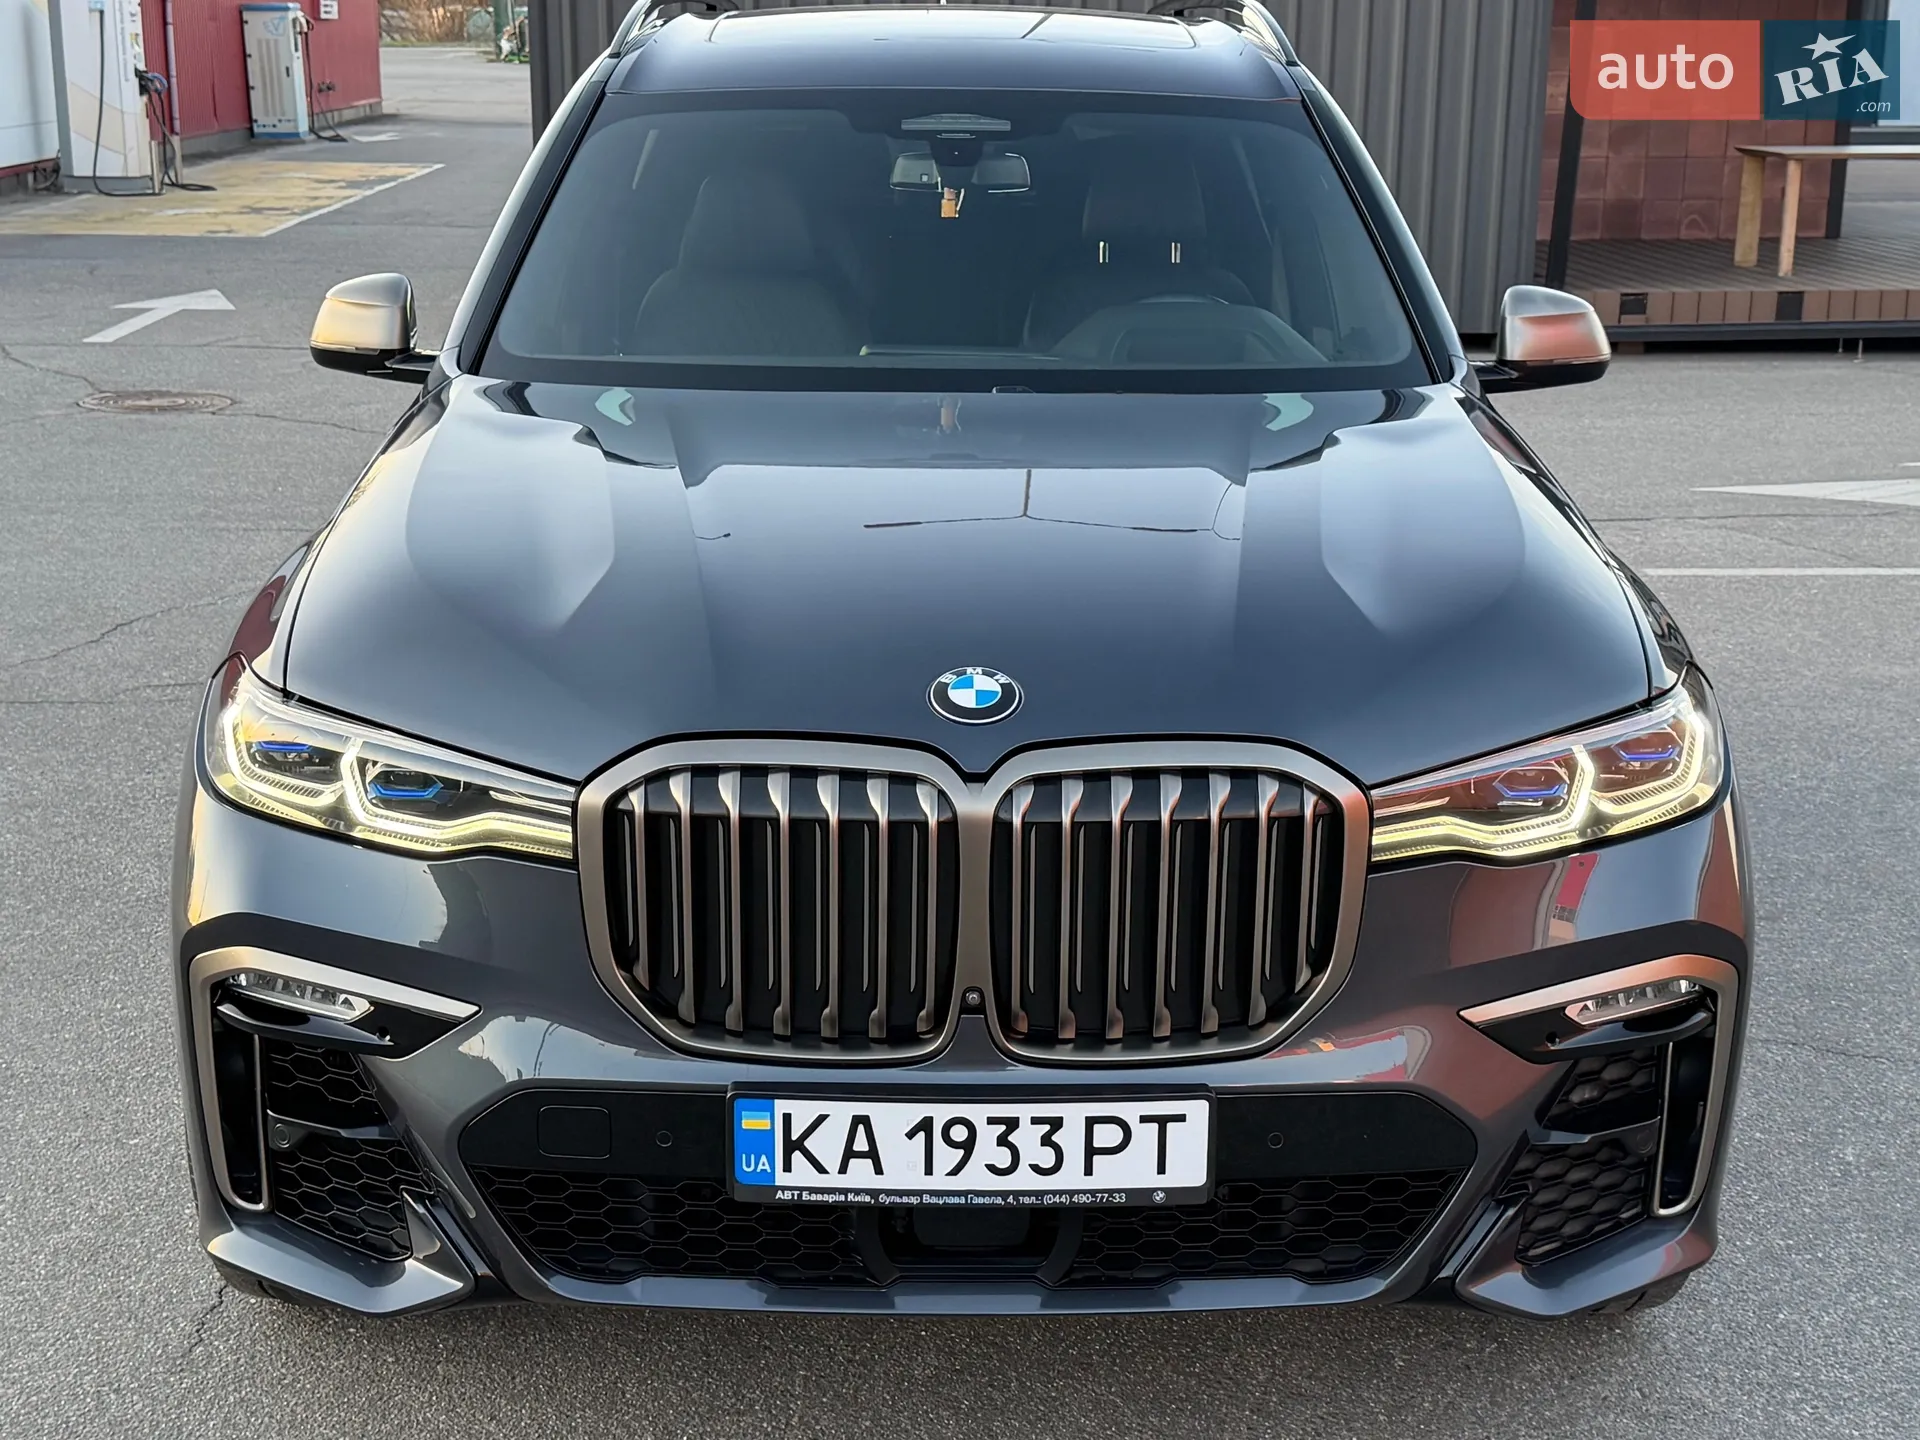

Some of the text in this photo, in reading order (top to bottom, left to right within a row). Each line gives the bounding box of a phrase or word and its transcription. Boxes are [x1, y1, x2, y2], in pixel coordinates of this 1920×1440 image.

[940, 667, 1010, 683] BMW
[782, 1112, 1187, 1177] KA 1933 PT
[742, 1153, 771, 1173] UA
[775, 1189, 800, 1200] АВТ
[802, 1190, 845, 1203] Баварія
[847, 1192, 875, 1205] Київ,
[879, 1193, 920, 1205] бульвар
[922, 1194, 965, 1205] Вацлава
[967, 1194, 1005, 1206] Гавела,
[1007, 1195, 1017, 1206] 4,
[1043, 1194, 1070, 1206] (044)
[1072, 1193, 1126, 1204] 490-77-33
